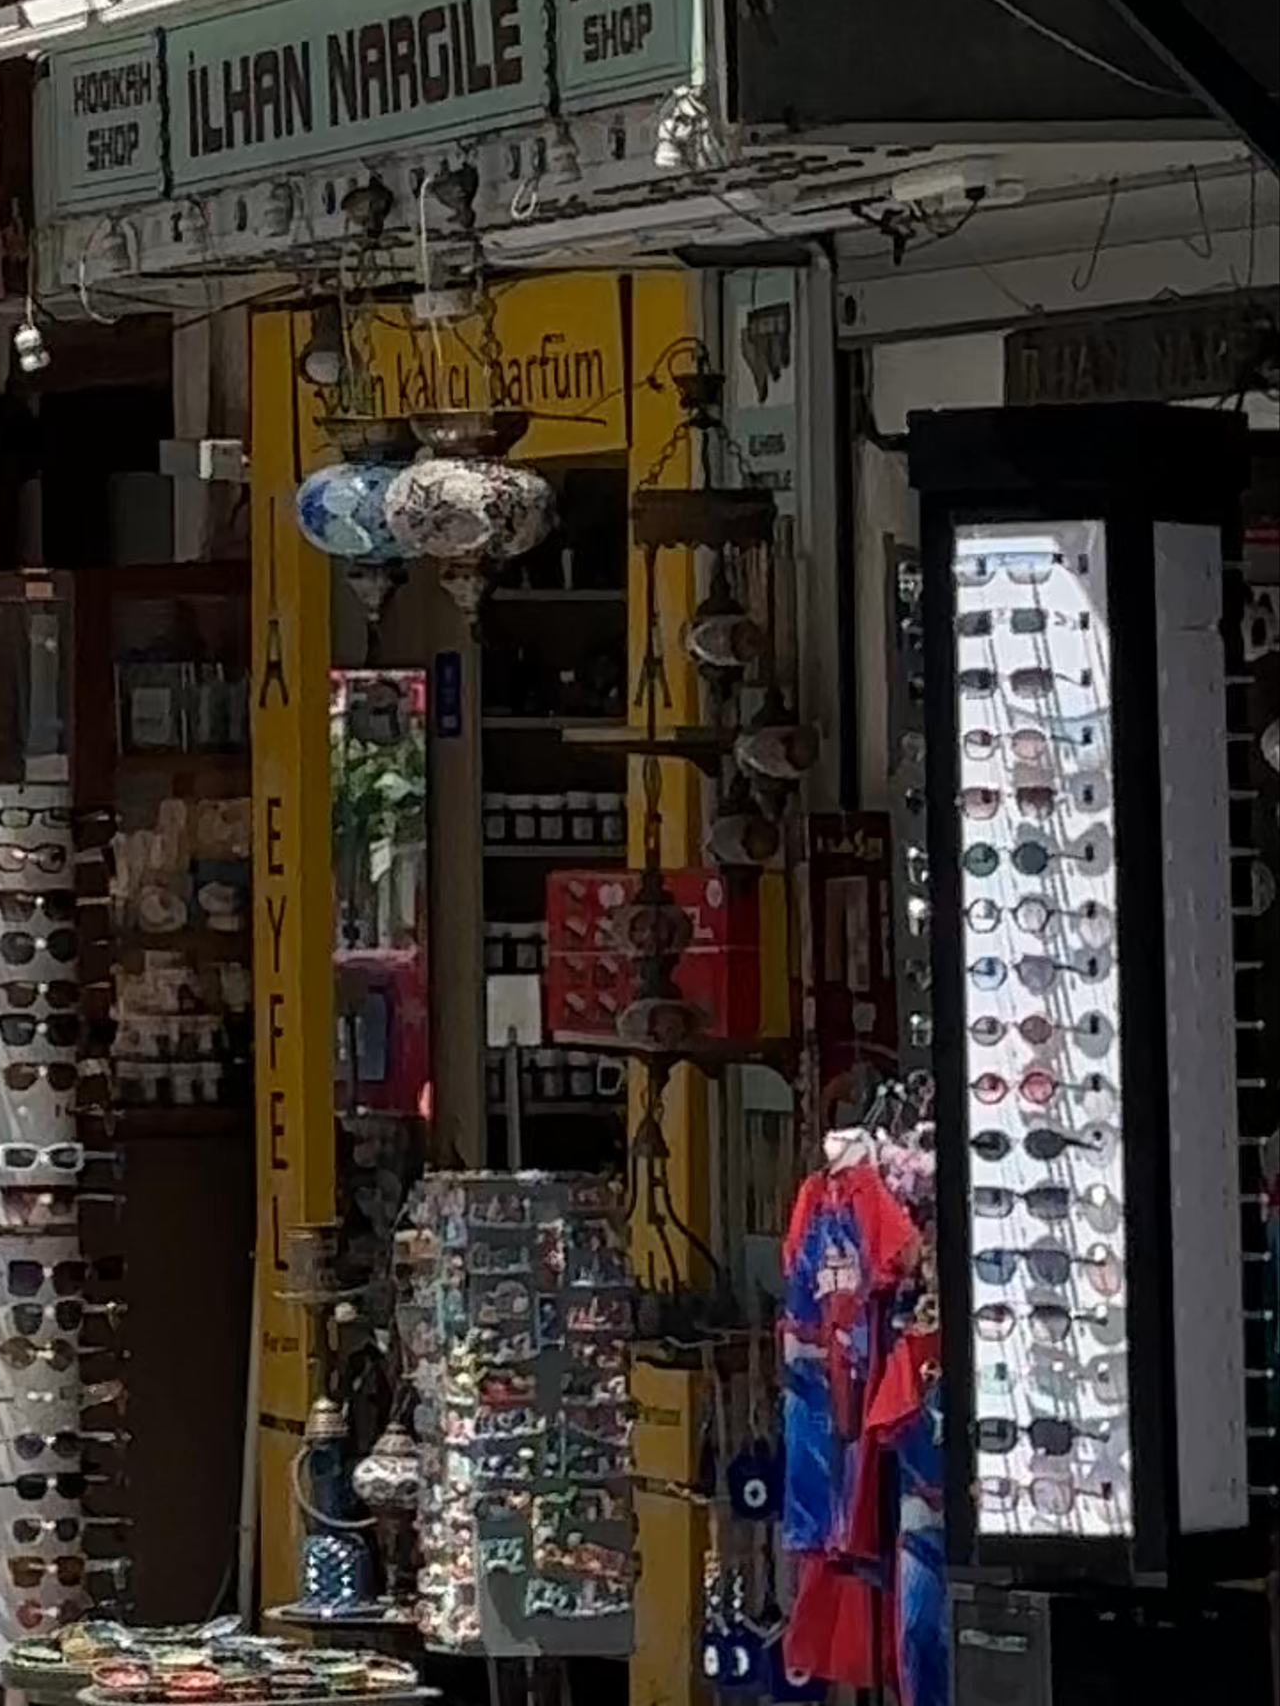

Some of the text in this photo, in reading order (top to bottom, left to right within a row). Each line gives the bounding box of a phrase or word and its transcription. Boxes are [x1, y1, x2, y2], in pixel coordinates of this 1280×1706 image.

[582, 3, 652, 63] SHOP
[72, 61, 152, 117] HOOKAH
[188, 41, 313, 158] İLHAN
[86, 122, 140, 172] SHOP
